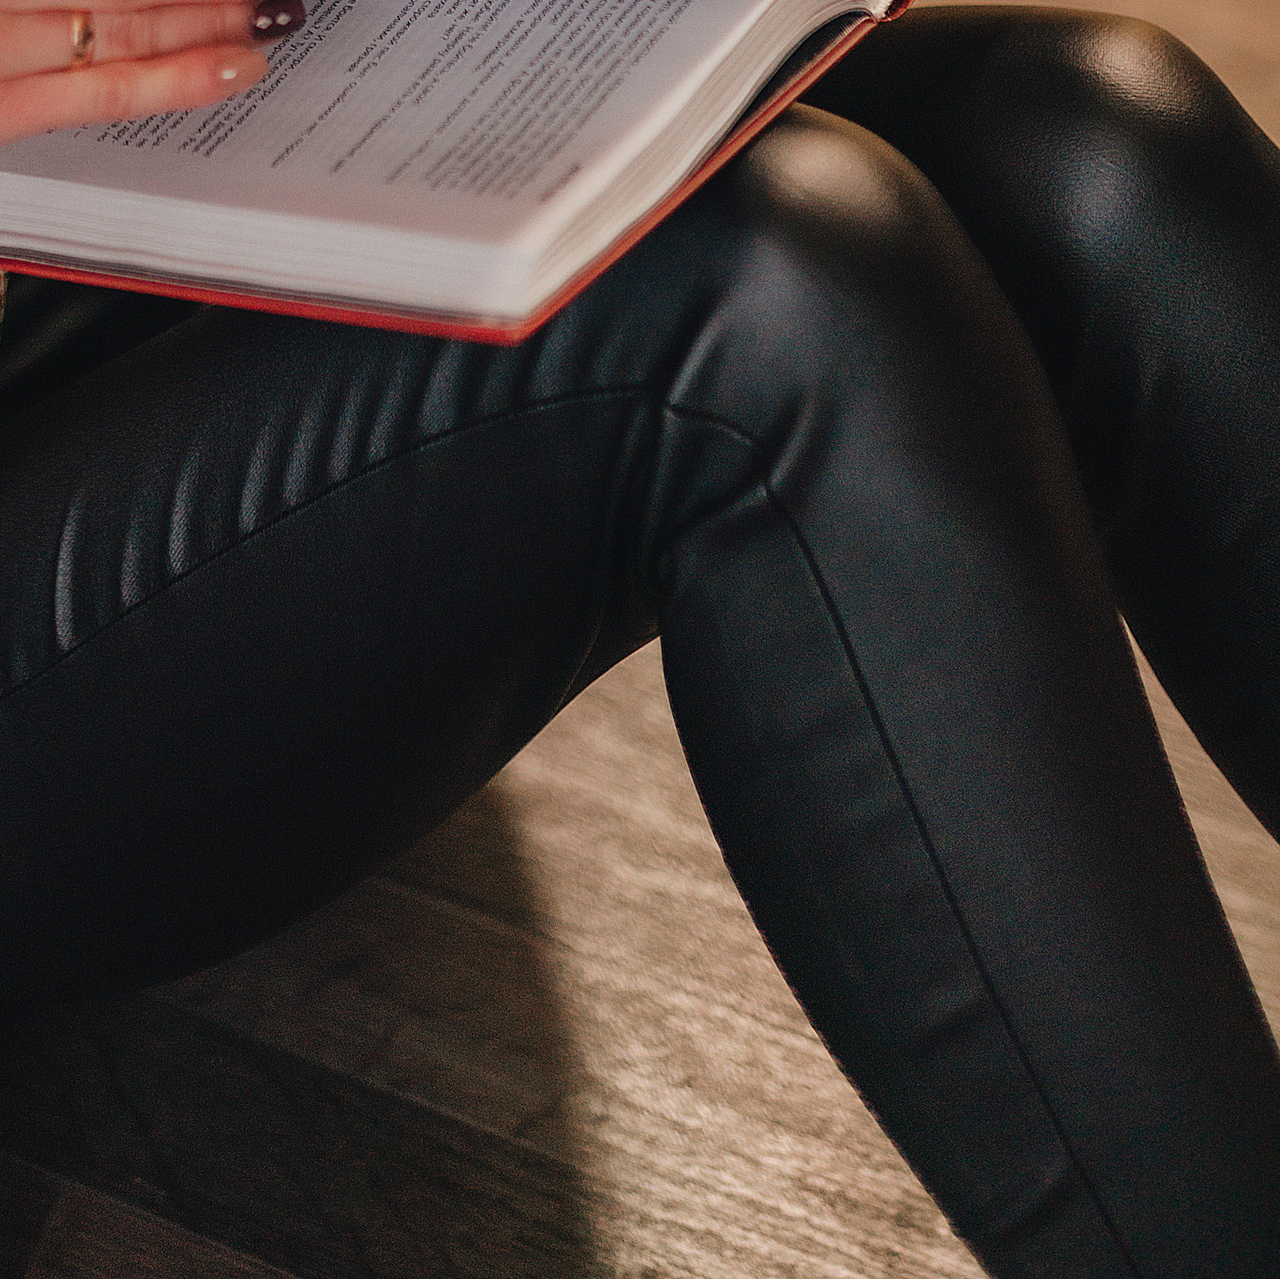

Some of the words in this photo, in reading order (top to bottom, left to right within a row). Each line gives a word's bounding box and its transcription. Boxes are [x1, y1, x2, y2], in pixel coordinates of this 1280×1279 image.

[324, 5, 351, 33] боится.
[286, 42, 314, 71] смотри,
[257, 72, 286, 102] смотри,
